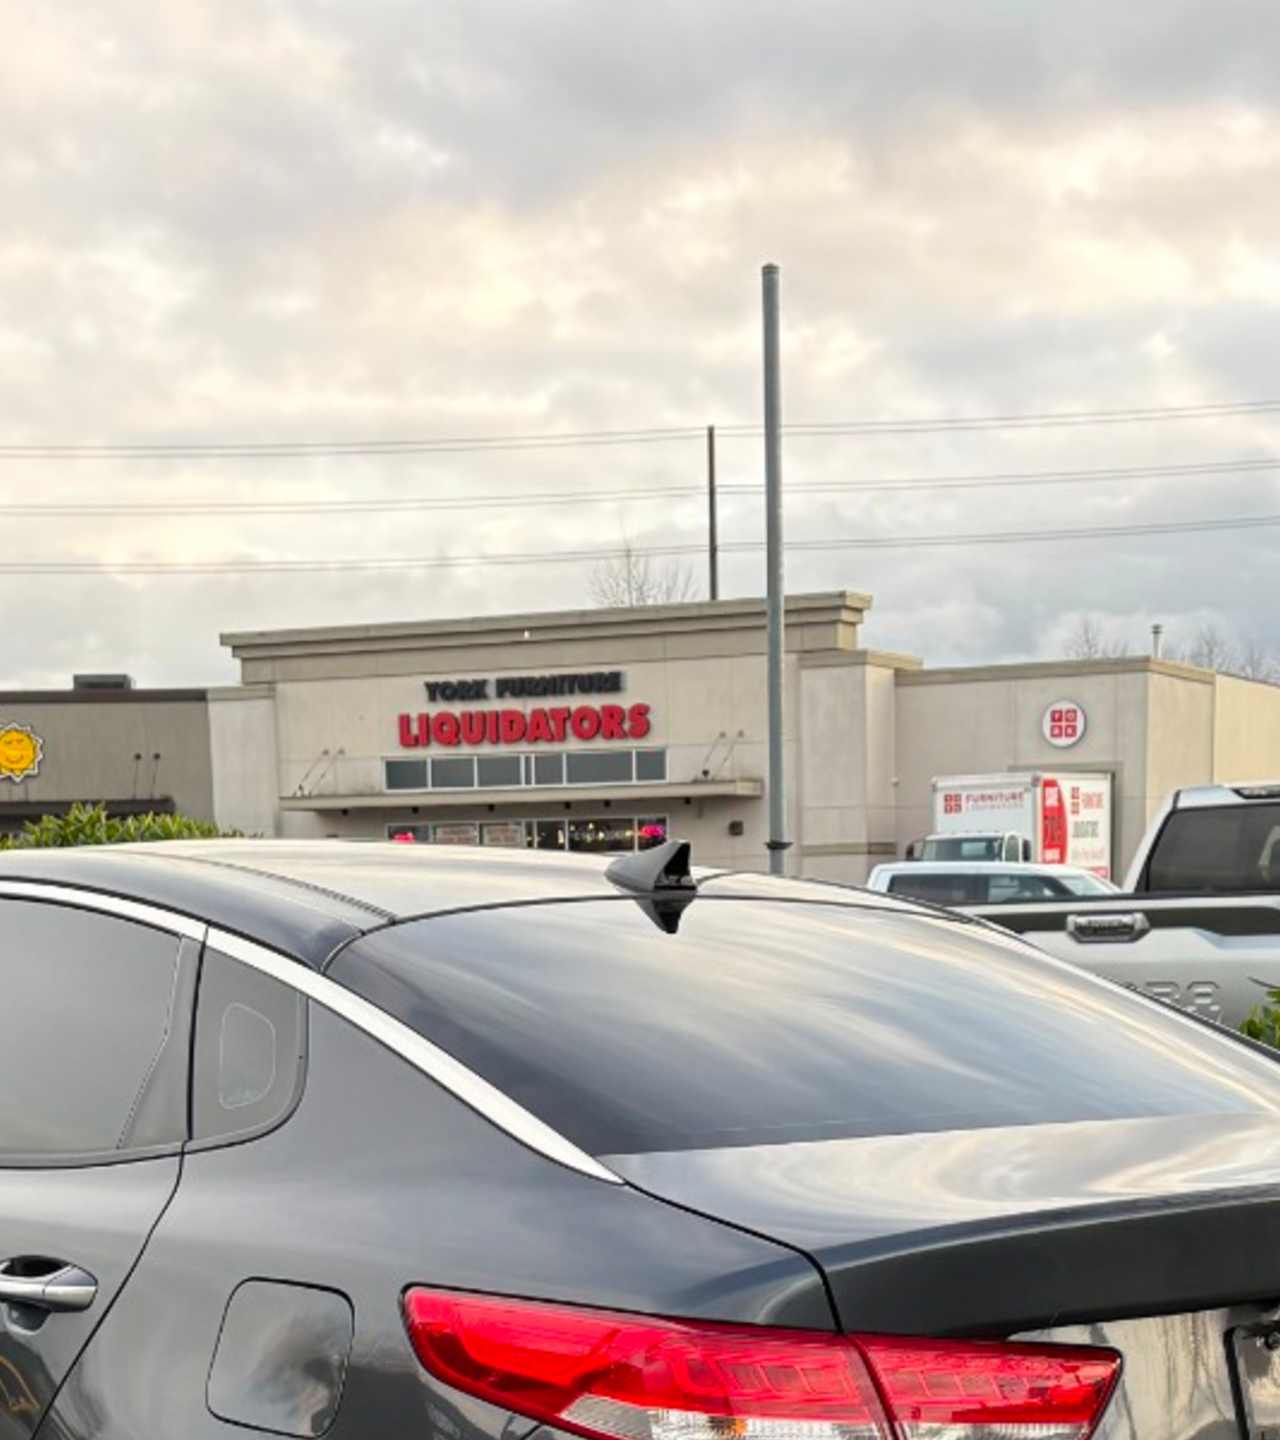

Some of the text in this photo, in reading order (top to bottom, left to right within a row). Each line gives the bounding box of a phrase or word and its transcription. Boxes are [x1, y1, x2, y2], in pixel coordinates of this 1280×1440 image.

[424, 671, 623, 702] YORK FURNITURE
[399, 703, 650, 747] LIQUIDATORS
